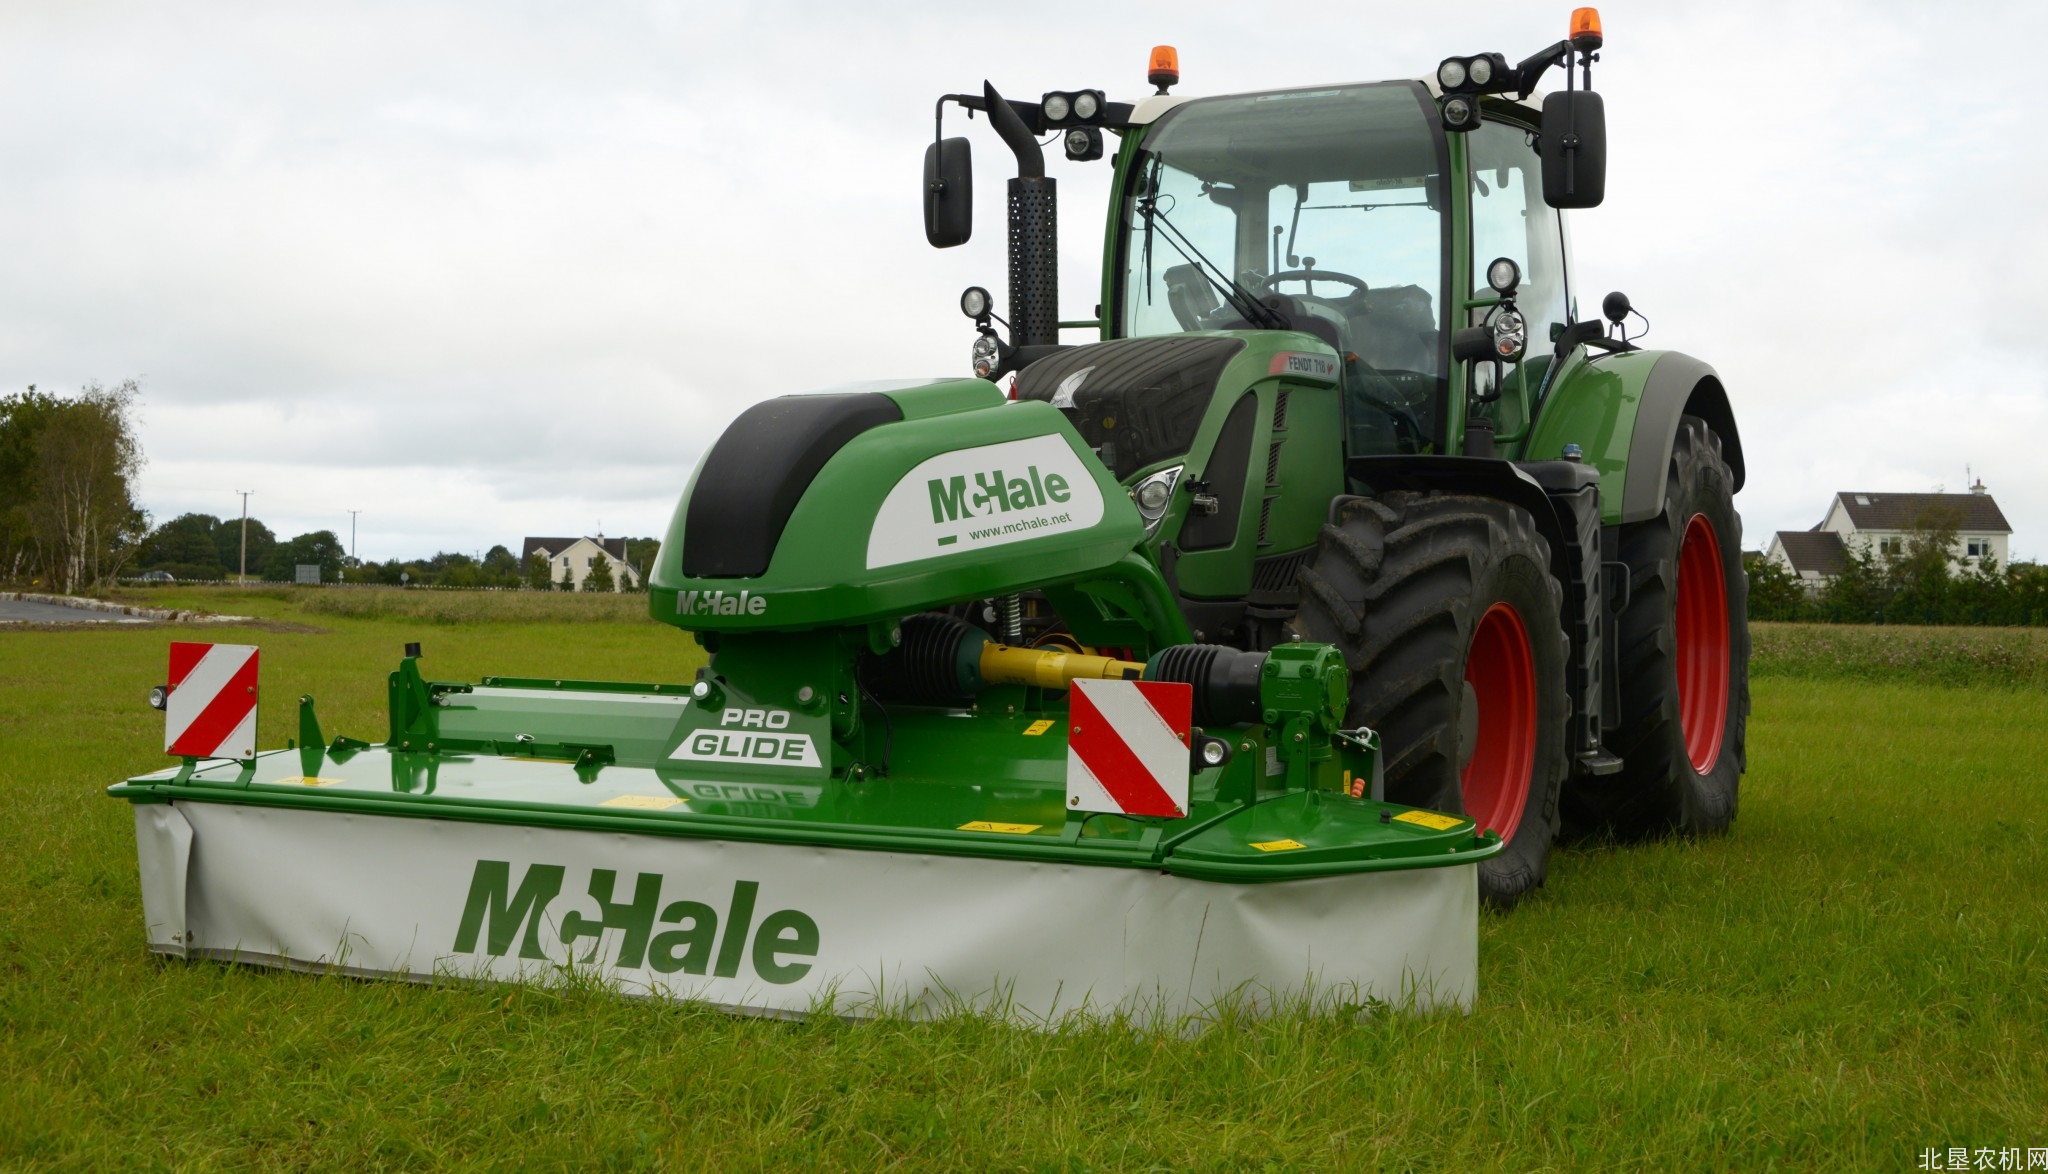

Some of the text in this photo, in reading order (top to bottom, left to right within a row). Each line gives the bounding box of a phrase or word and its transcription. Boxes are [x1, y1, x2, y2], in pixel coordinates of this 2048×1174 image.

[1288, 356, 1326, 374] FENDT 718
[928, 465, 1071, 524] McHale
[969, 512, 1072, 541] www.mchale.net
[675, 590, 767, 616] McHale
[721, 708, 790, 729] PRO
[691, 734, 807, 761] GLIDE
[452, 859, 820, 985] McHale
